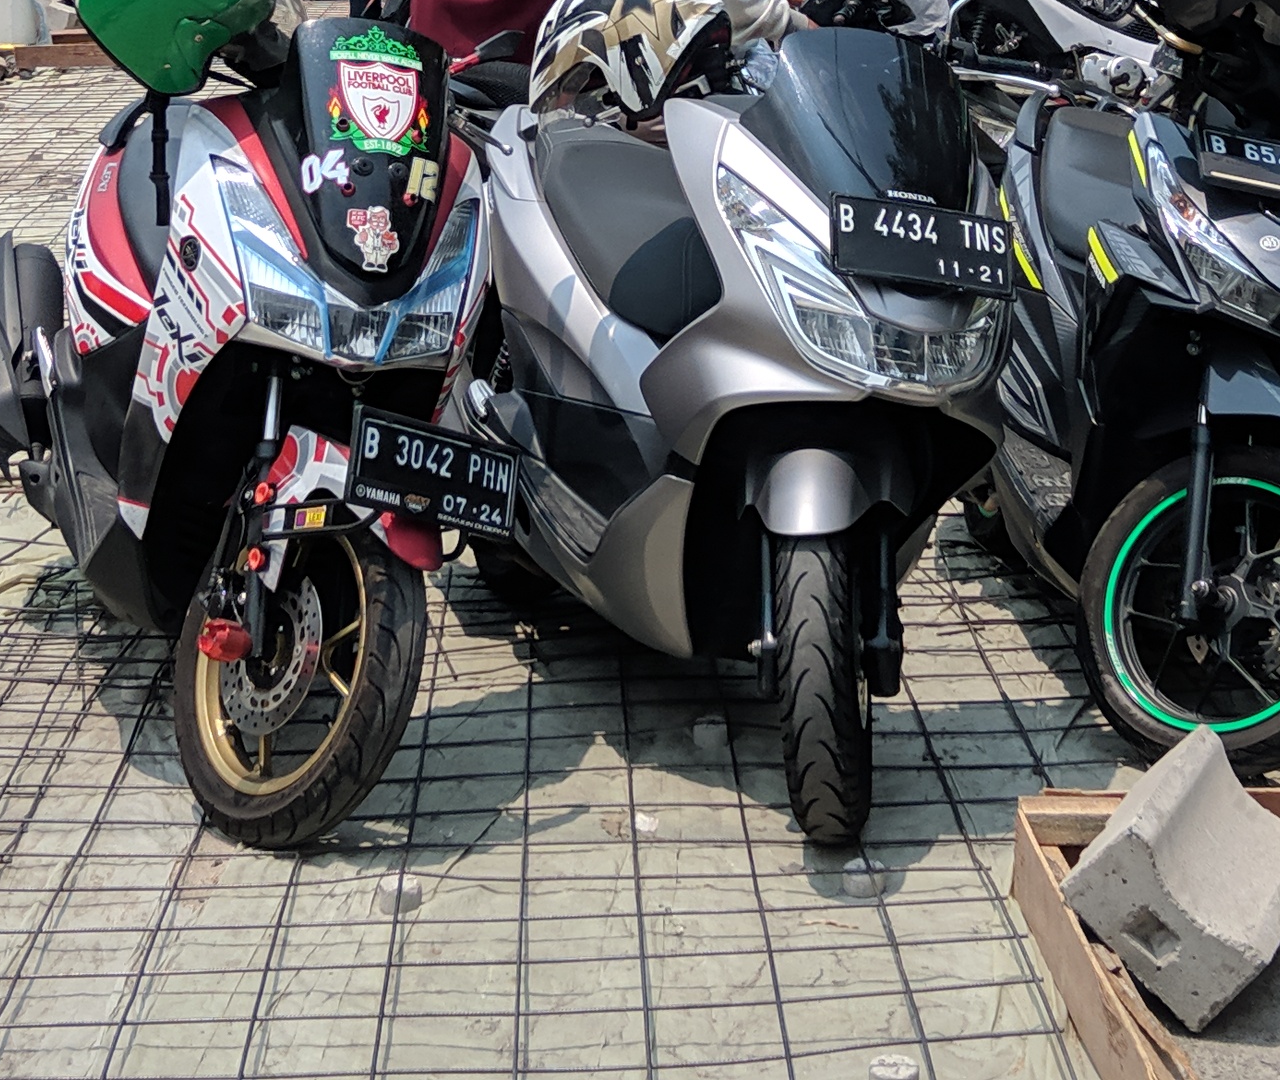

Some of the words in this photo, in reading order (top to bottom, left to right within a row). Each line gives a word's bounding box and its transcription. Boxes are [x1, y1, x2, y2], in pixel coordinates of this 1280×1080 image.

[347, 70, 412, 89] LIVERPOOL
[347, 80, 390, 92] FOOTBALL
[392, 85, 413, 96] CLUB
[1210, 134, 1227, 154] B
[302, 149, 349, 194] 04
[887, 189, 937, 205] HONDA
[839, 203, 855, 233] B
[874, 208, 938, 245] 4434
[959, 219, 1007, 255] TNS
[363, 425, 381, 460] B
[394, 434, 455, 479] 3042
[468, 451, 511, 494] PHN
[365, 486, 401, 506] YAMAHA
